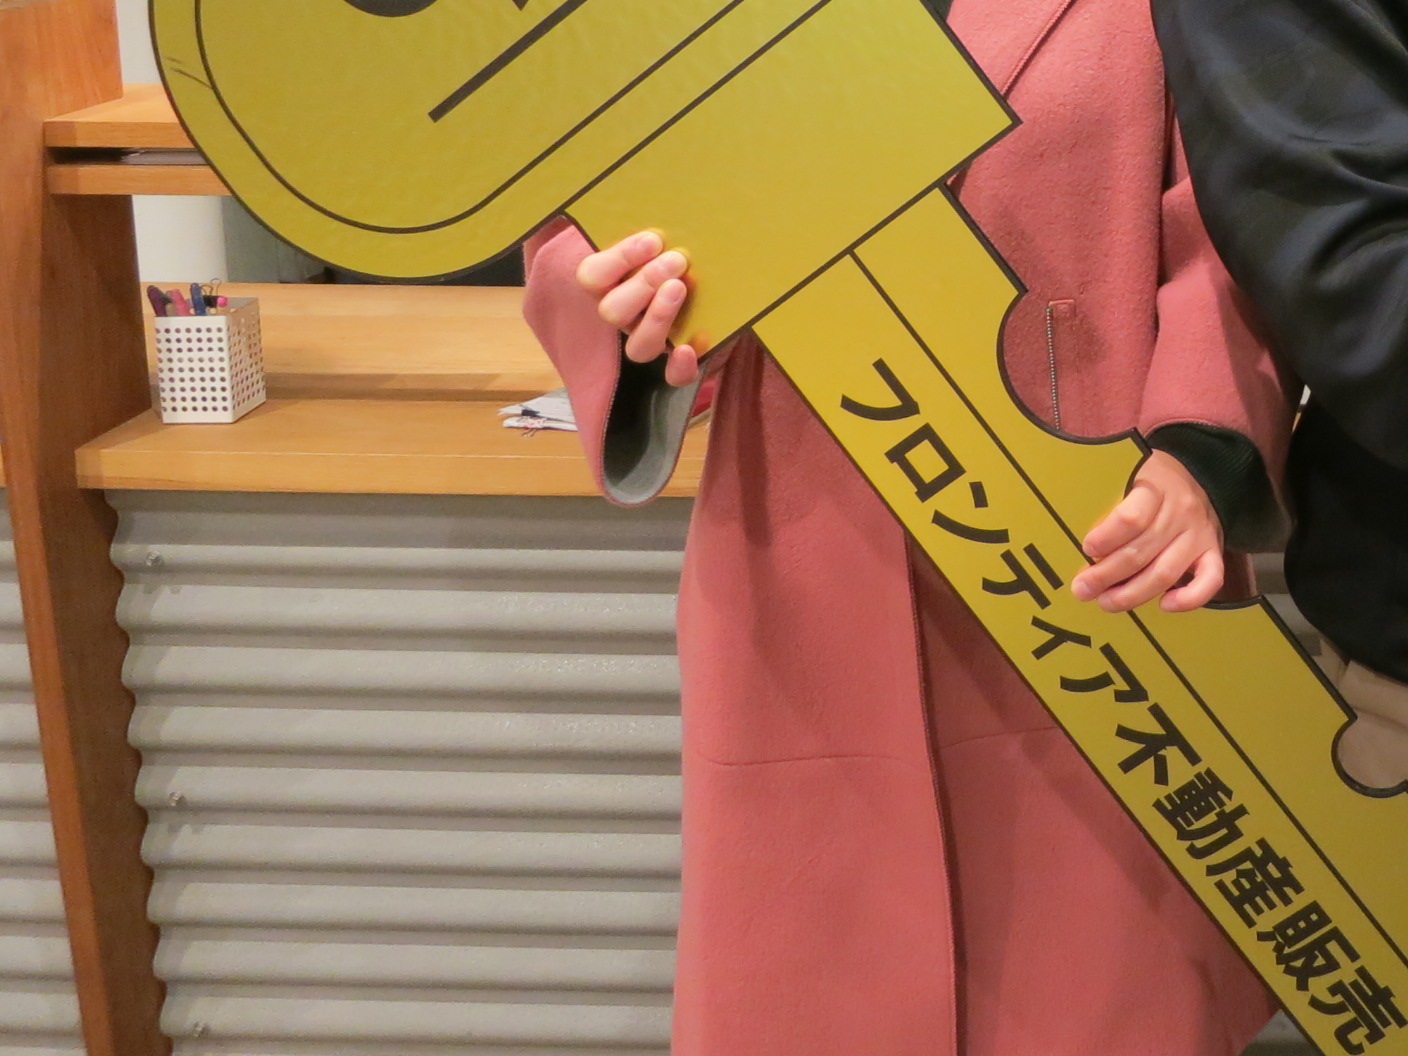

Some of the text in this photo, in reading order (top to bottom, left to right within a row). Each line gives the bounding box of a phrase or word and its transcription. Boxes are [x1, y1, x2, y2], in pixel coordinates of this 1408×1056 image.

[839, 357, 1408, 1055] フロンティア不動産販売
